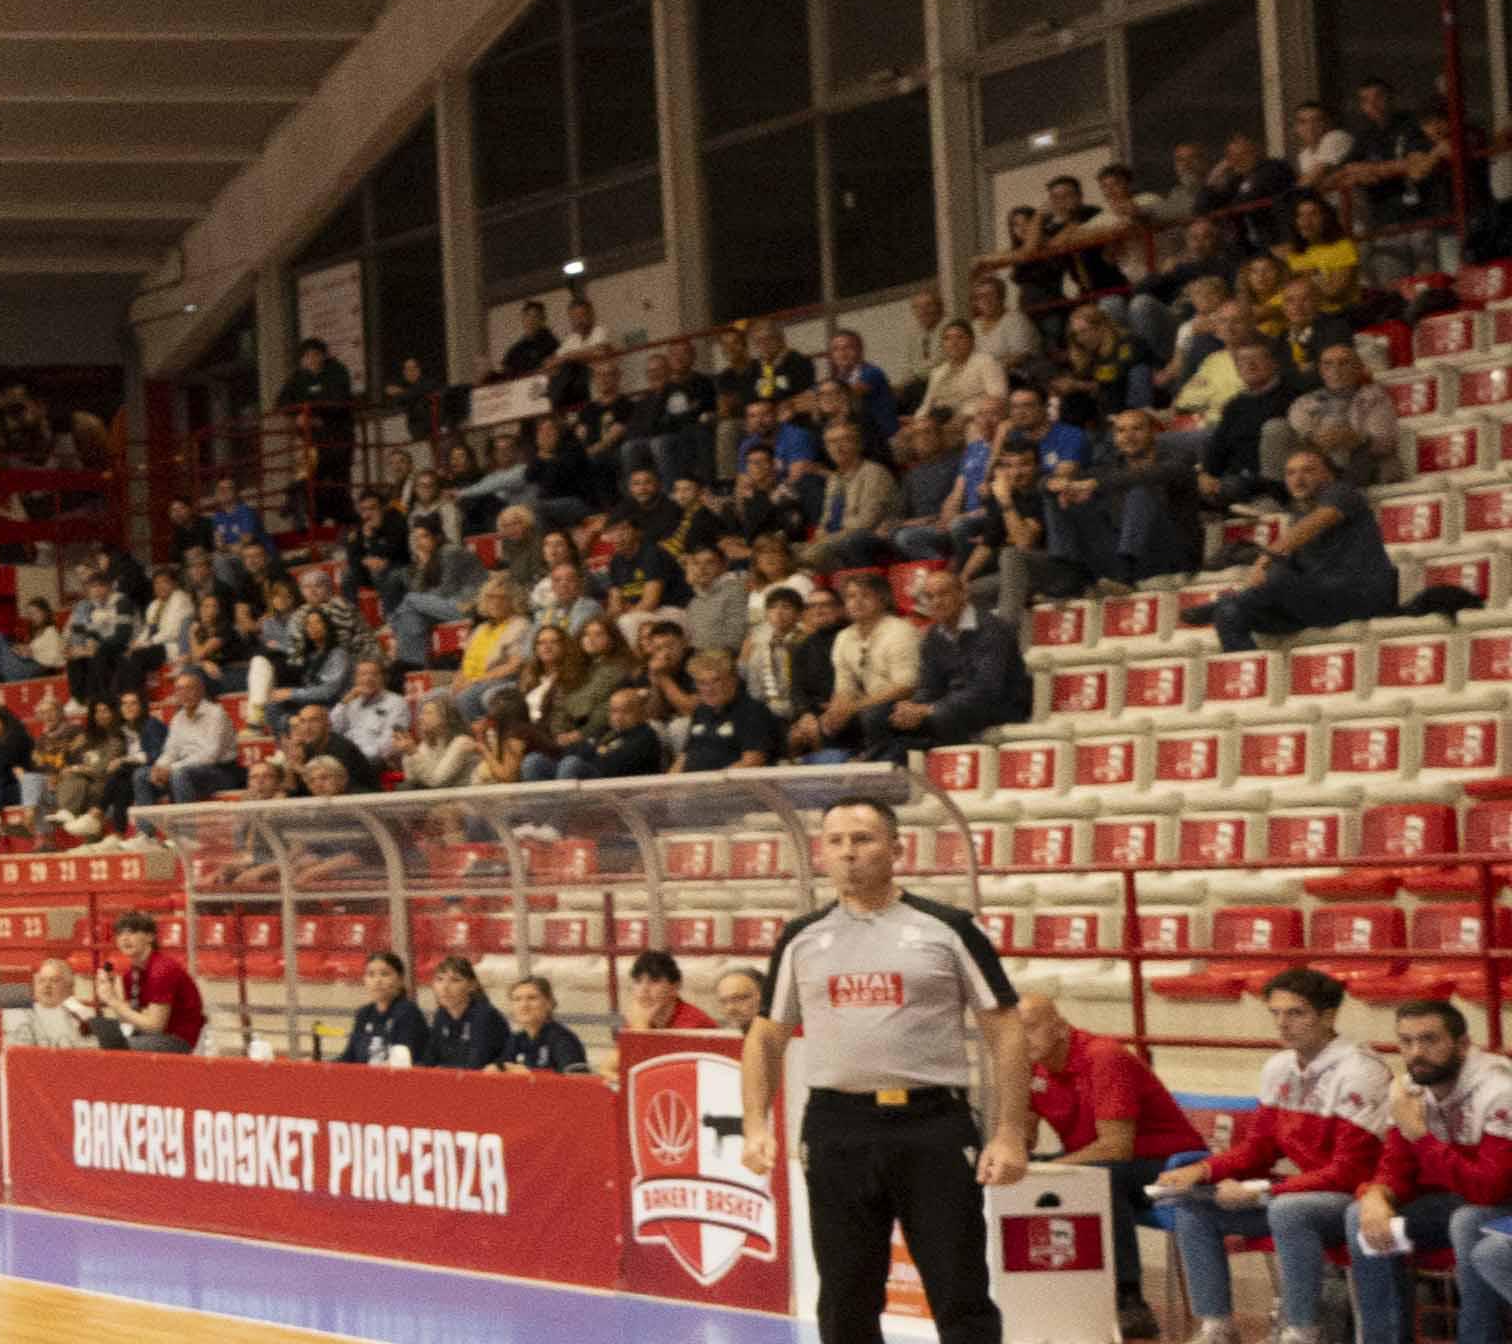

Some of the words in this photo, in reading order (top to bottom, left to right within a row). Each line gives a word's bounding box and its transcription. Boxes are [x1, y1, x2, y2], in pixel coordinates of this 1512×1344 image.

[72, 1099, 186, 1178] BAKERY
[193, 1110, 318, 1193] BASKET
[328, 1121, 509, 1215] PIACENZA
[644, 1187, 697, 1210] BAKERY
[706, 1189, 763, 1224] BASKET
